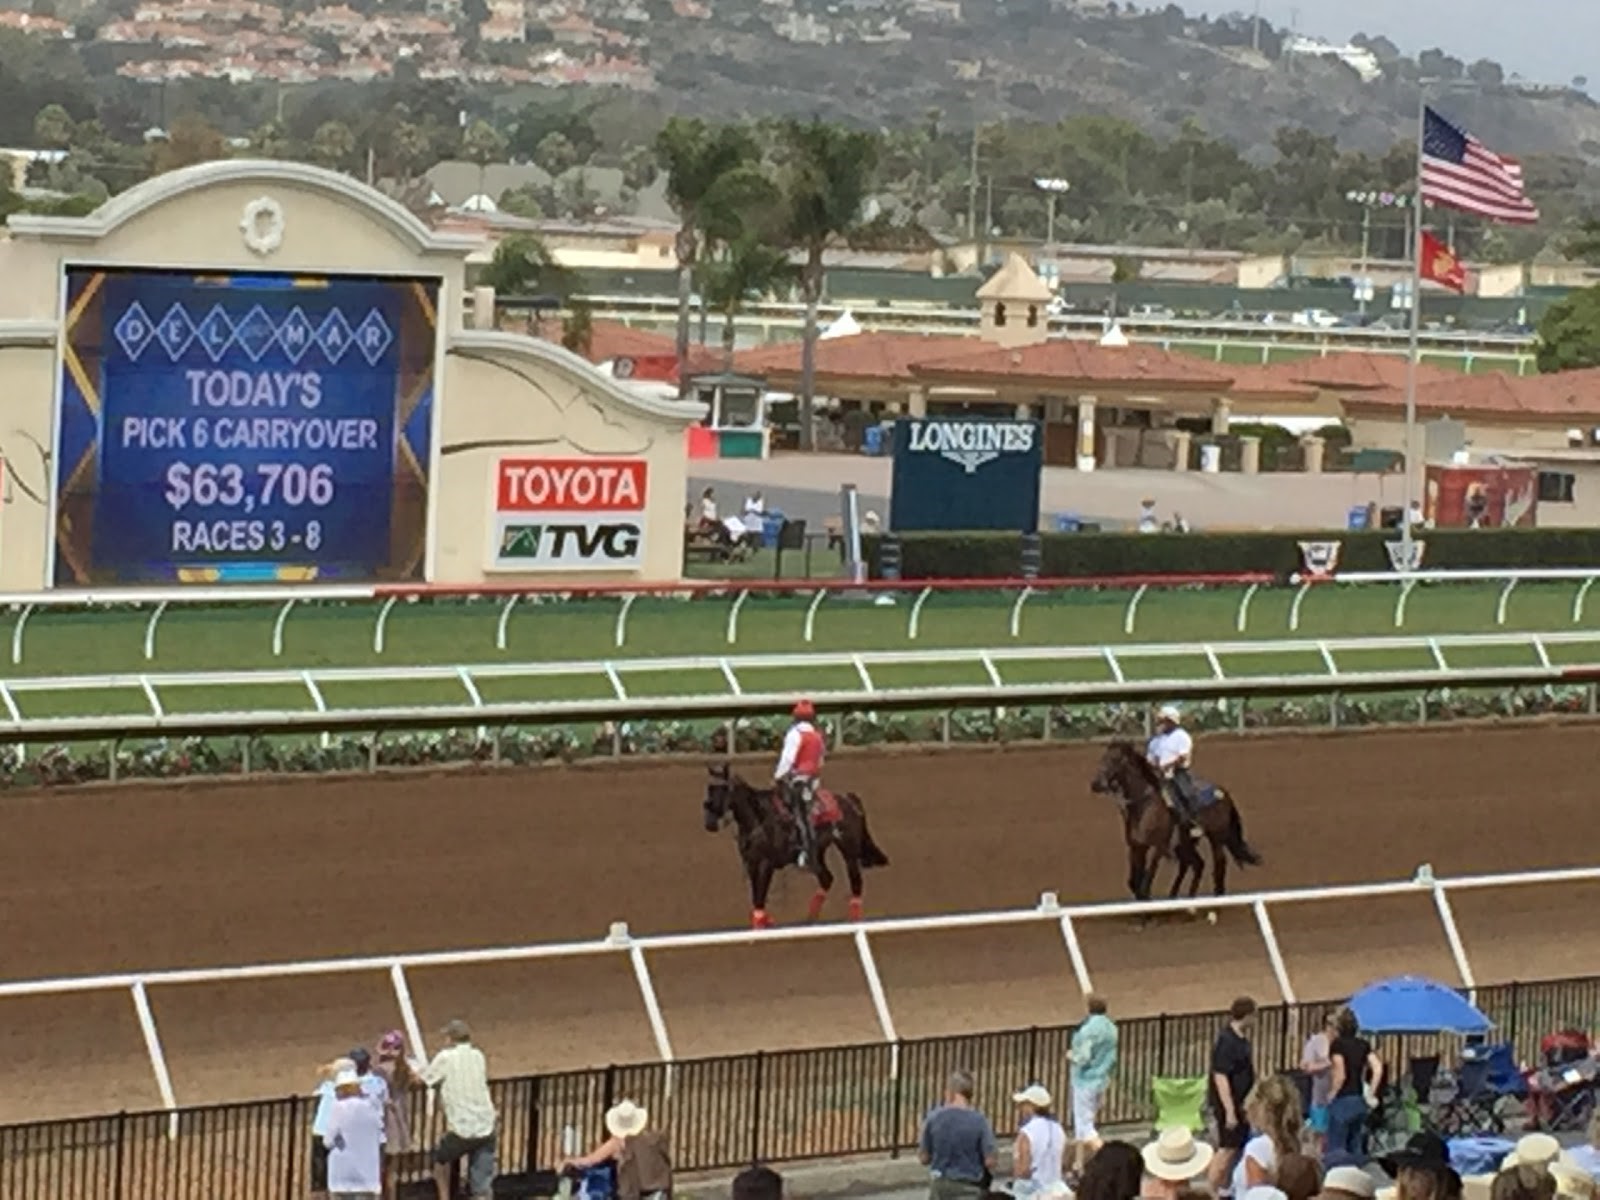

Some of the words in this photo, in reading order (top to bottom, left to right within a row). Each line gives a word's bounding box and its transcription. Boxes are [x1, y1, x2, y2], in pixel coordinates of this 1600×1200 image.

[185, 370, 322, 409] TODAY'S
[122, 417, 186, 448] PICK
[192, 417, 208, 448] 6
[213, 418, 378, 449] CARRYOVER
[908, 421, 1036, 452] LONGINES
[164, 460, 334, 512] $63,706
[504, 466, 640, 505] TOYOTA
[171, 520, 266, 552] RACES
[270, 520, 285, 550] 3
[306, 520, 322, 551] 8
[544, 523, 641, 558] TVG
